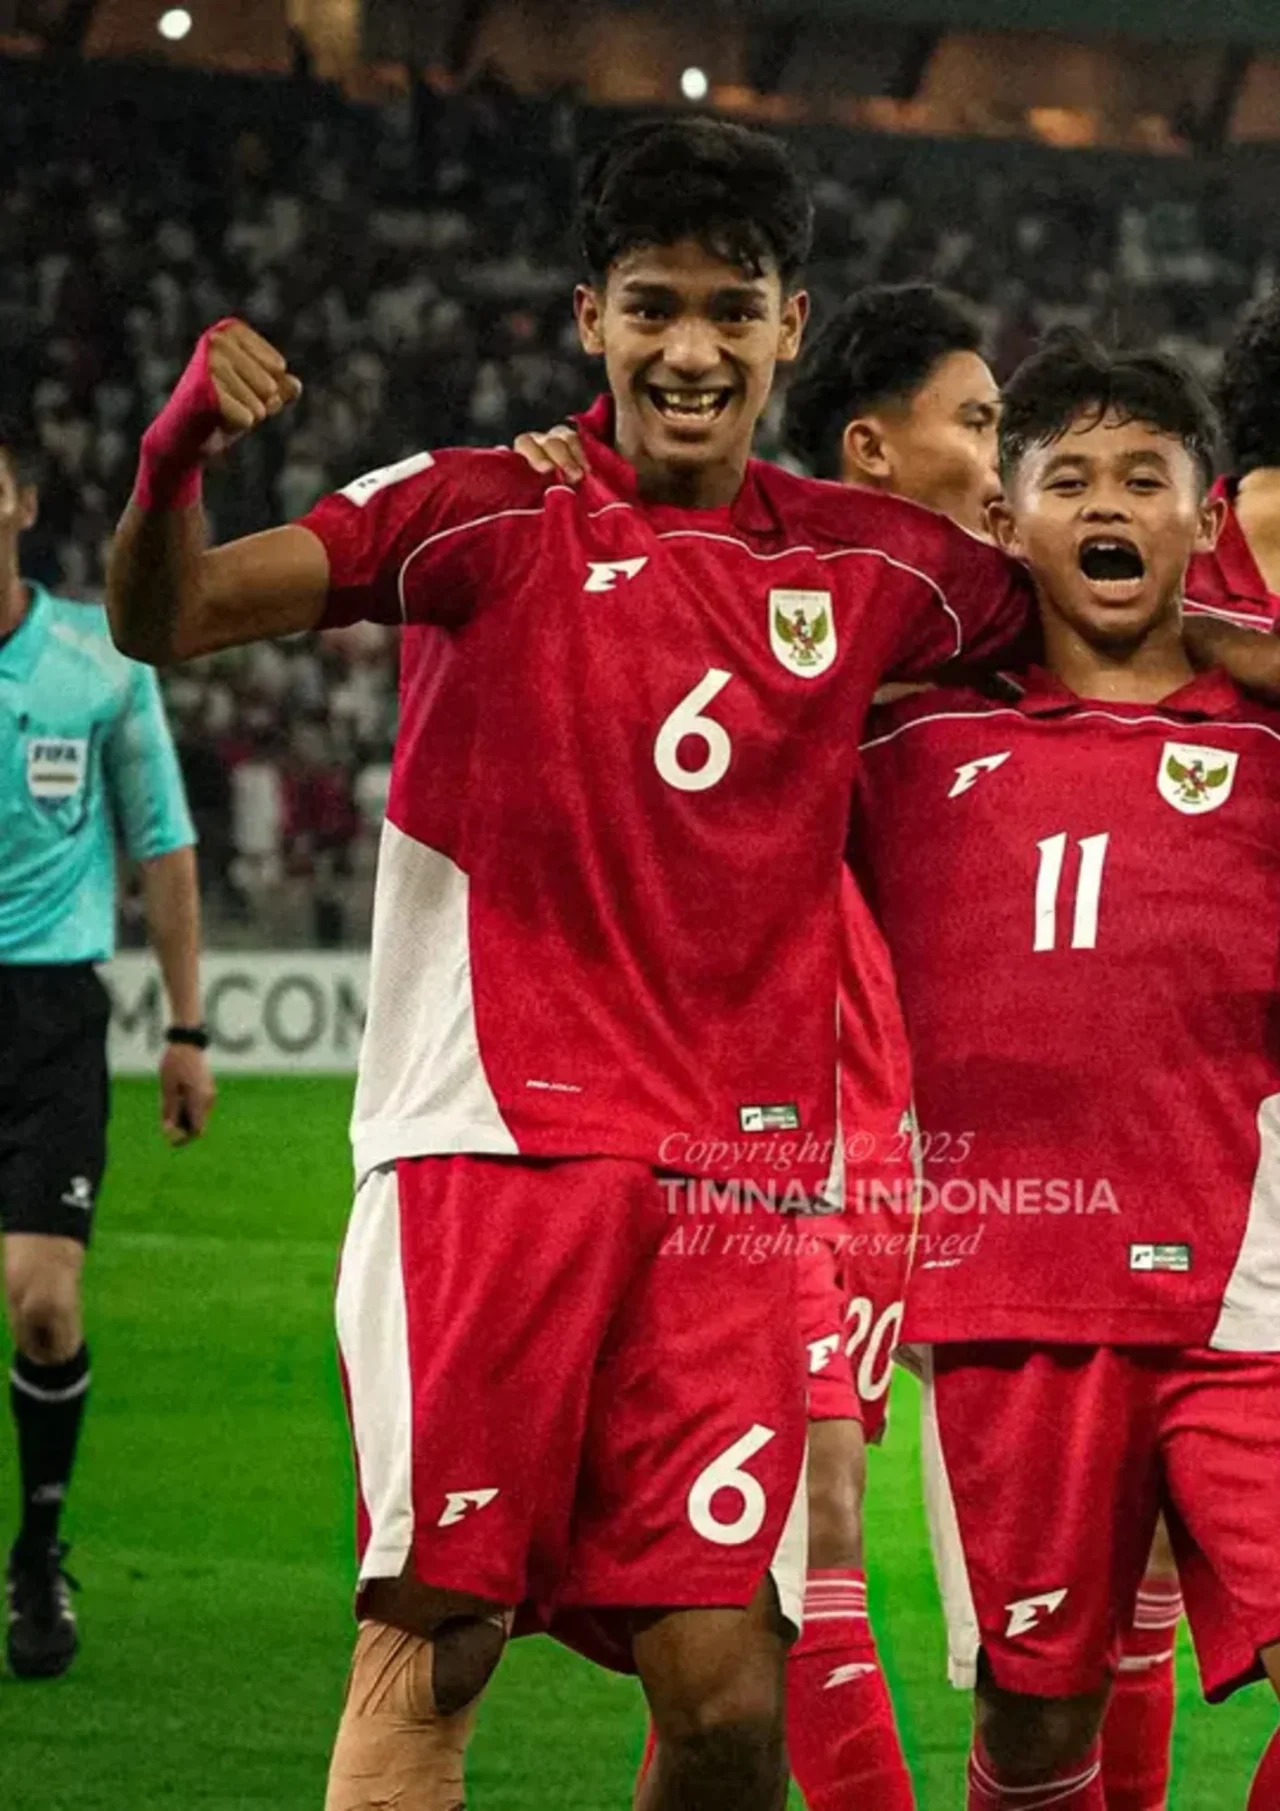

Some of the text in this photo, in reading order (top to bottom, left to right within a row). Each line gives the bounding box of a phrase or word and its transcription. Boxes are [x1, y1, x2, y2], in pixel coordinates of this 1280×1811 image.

[33, 744, 77, 761] FIFA
[653, 667, 732, 791] 6
[1033, 832, 1109, 952] 11
[687, 1423, 776, 1545] 6
